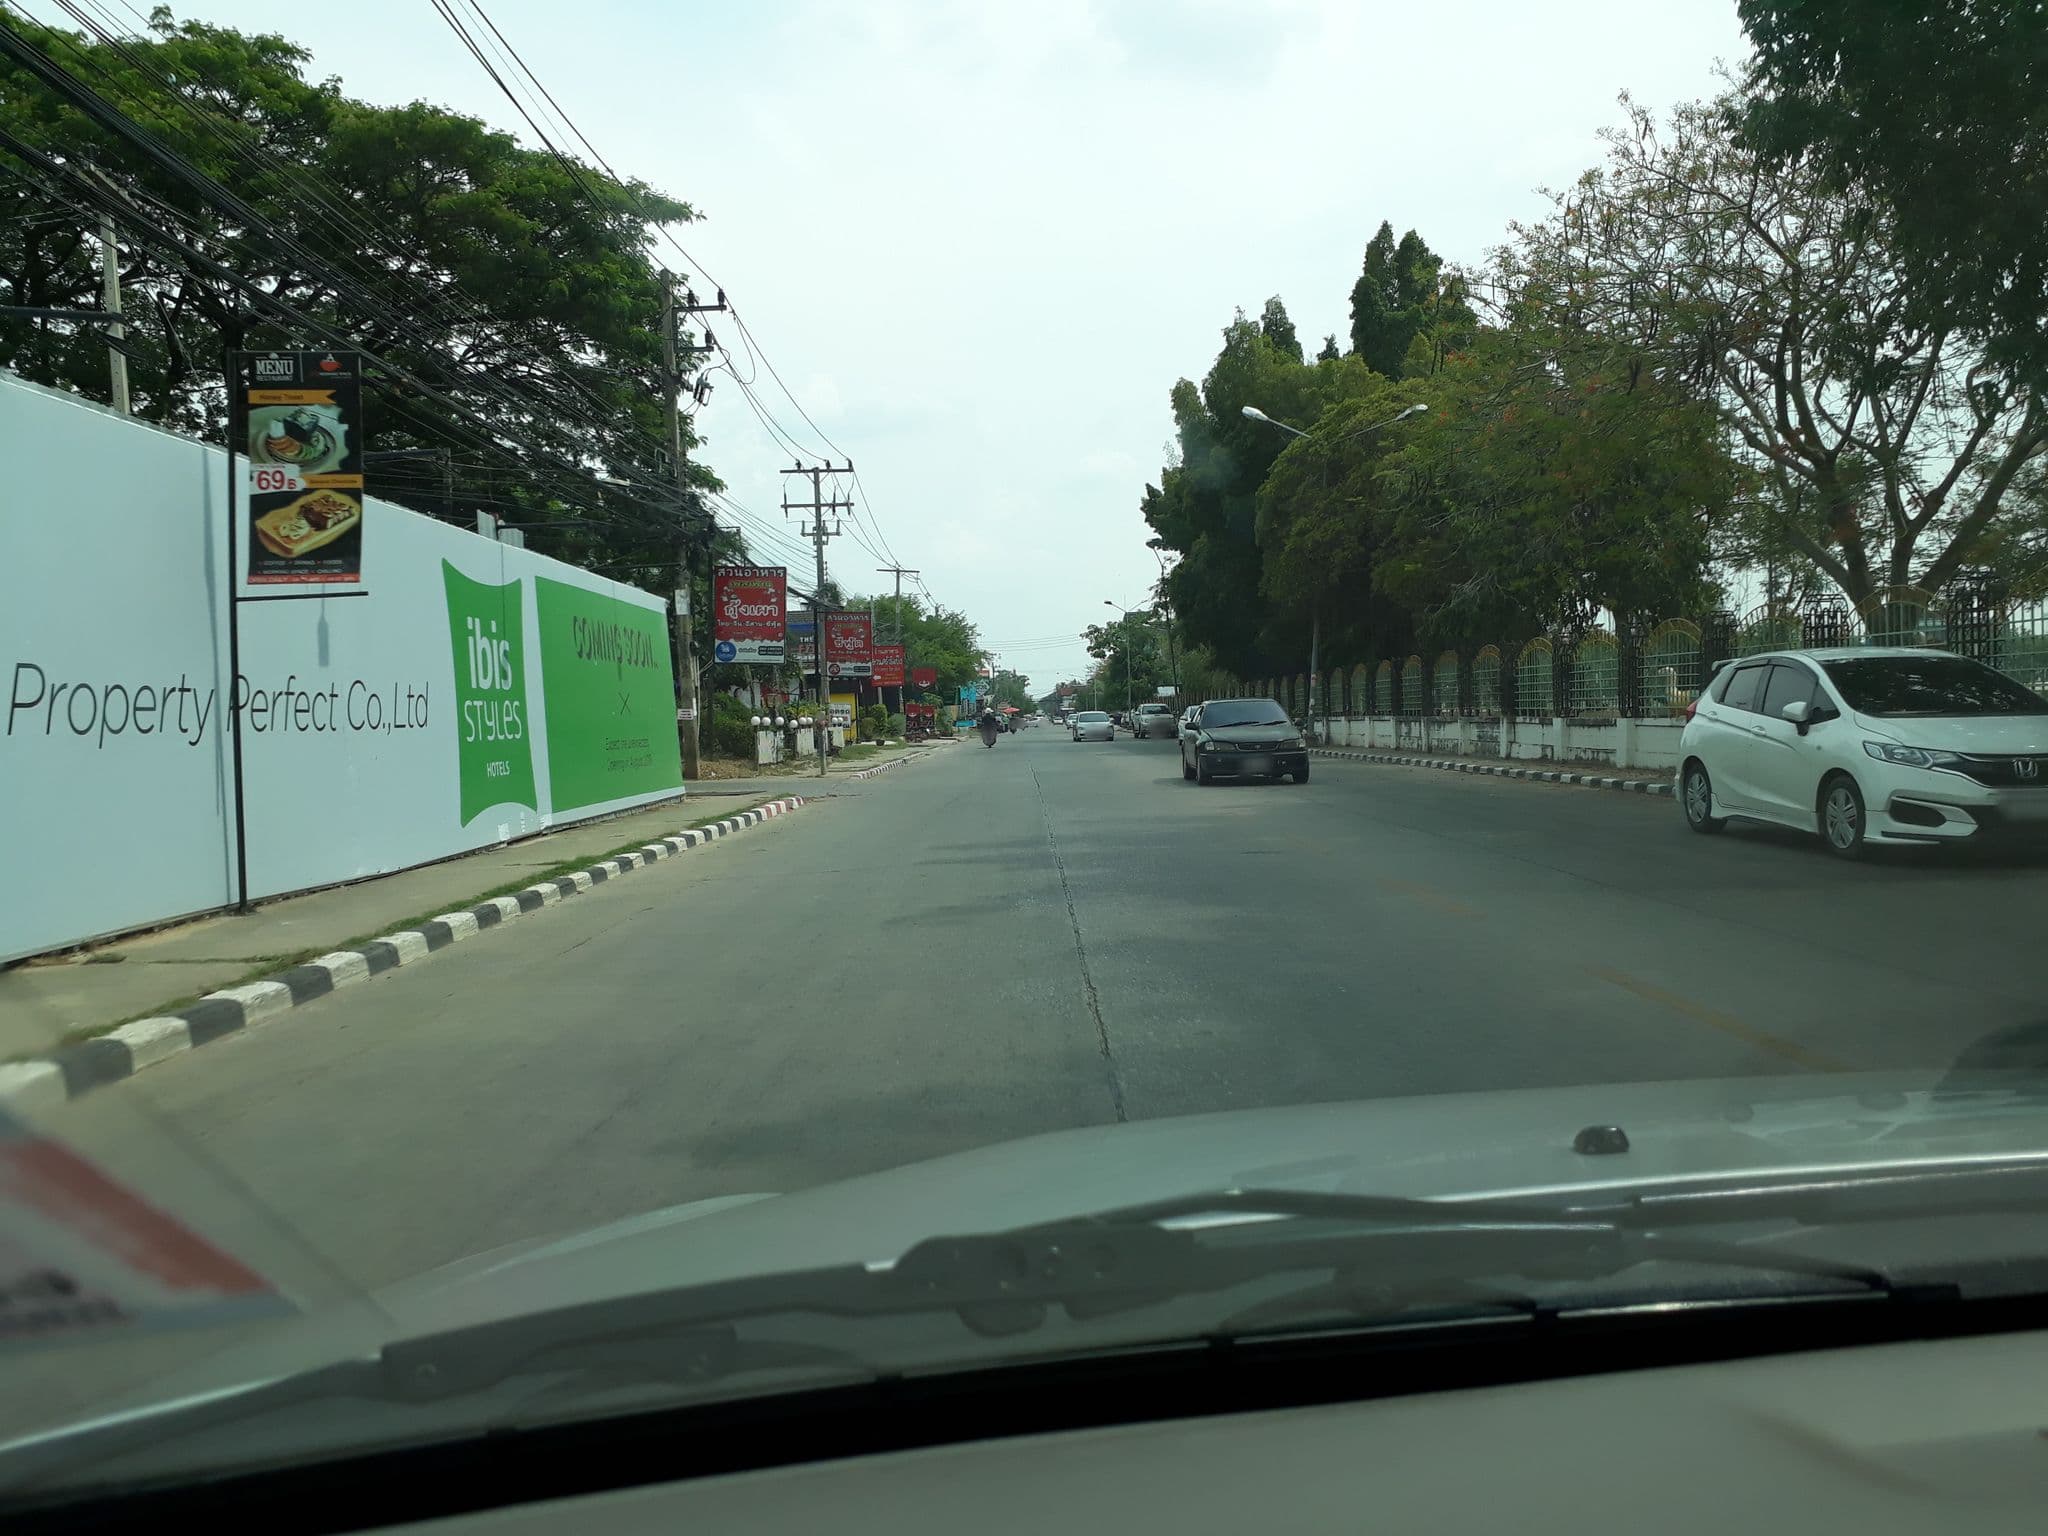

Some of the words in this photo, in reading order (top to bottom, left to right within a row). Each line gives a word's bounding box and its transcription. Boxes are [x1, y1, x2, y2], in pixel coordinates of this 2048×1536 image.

[255, 360, 294, 375] MENU
[717, 567, 785, 577] สวนอาหาร
[466, 616, 513, 690] ibis
[572, 615, 623, 665] COMING
[7, 662, 215, 749] Property
[226, 674, 339, 732] Perfect
[486, 760, 511, 778] HOTELS
